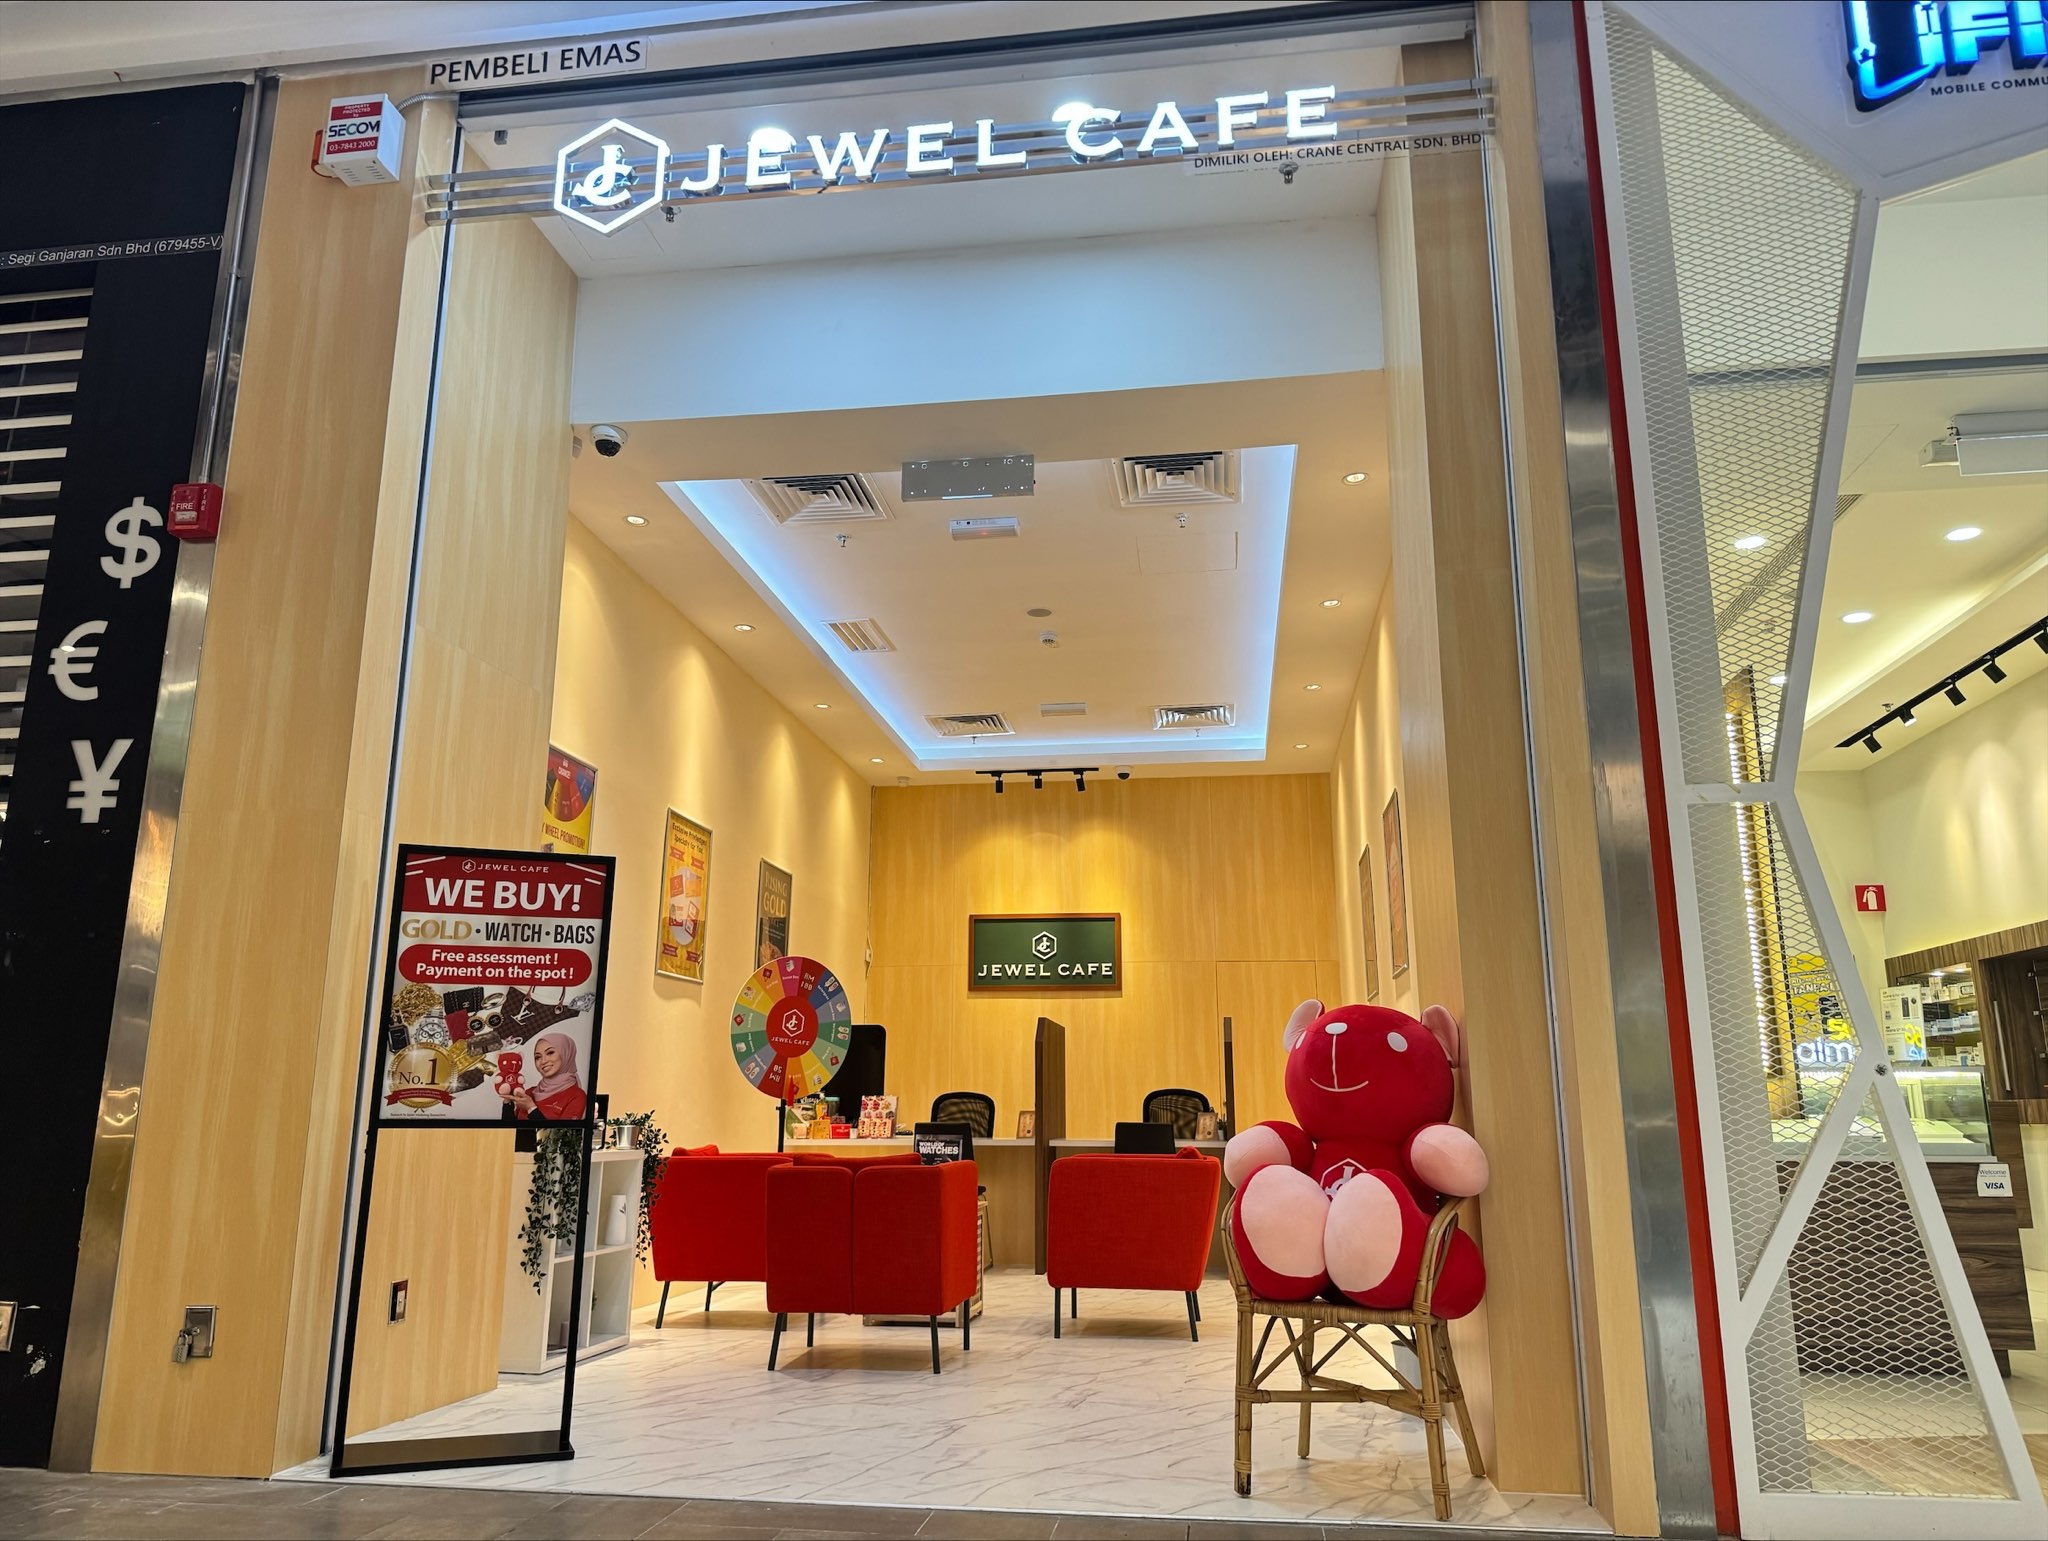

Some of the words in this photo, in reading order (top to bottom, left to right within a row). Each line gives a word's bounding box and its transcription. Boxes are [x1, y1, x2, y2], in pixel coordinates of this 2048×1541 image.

[430, 51, 548, 85] PEMBELI
[560, 41, 641, 70] EMAS
[1930, 82, 1986, 96] MOBILE
[328, 120, 381, 138] SECOM
[329, 141, 357, 152] 03-7843
[358, 139, 376, 149] 2000
[680, 119, 1028, 197] JEWEL
[1060, 85, 1338, 161] CAFE
[1194, 153, 1250, 169] DIMILIKI
[1253, 152, 1293, 163] OLEH:
[1296, 145, 1345, 160] CRANE
[1347, 139, 1410, 155] CENTRAL
[1413, 136, 1447, 149] SDN.
[8, 253, 36, 266] Segi
[38, 248, 94, 263] Ganjaran
[97, 244, 123, 258] Sdn
[126, 241, 151, 255] Bhd
[154, 235, 225, 255] (679455-V)
[176, 502, 194, 510] FIRE
[478, 863, 517, 871] JEWEL
[520, 865, 549, 873] CAFE
[765, 871, 788, 897] RISING
[425, 877, 485, 908] WE
[493, 881, 581, 912] BUY!
[763, 891, 787, 918] GOLD
[401, 918, 472, 941] GOLD
[485, 922, 542, 943] WATCH
[553, 924, 595, 944] BAGS
[431, 948, 464, 962] Free
[467, 952, 551, 965] assessment
[416, 962, 482, 979] Payment
[485, 968, 504, 978] on
[507, 965, 531, 978] the
[534, 967, 567, 981] spot
[978, 963, 1051, 977] JEWEL
[1057, 962, 1113, 976] CAFE
[771, 1036, 793, 1044] JEWEL
[919, 1146, 959, 1155] WATCHES
[1985, 1182, 2005, 1190] VISA
